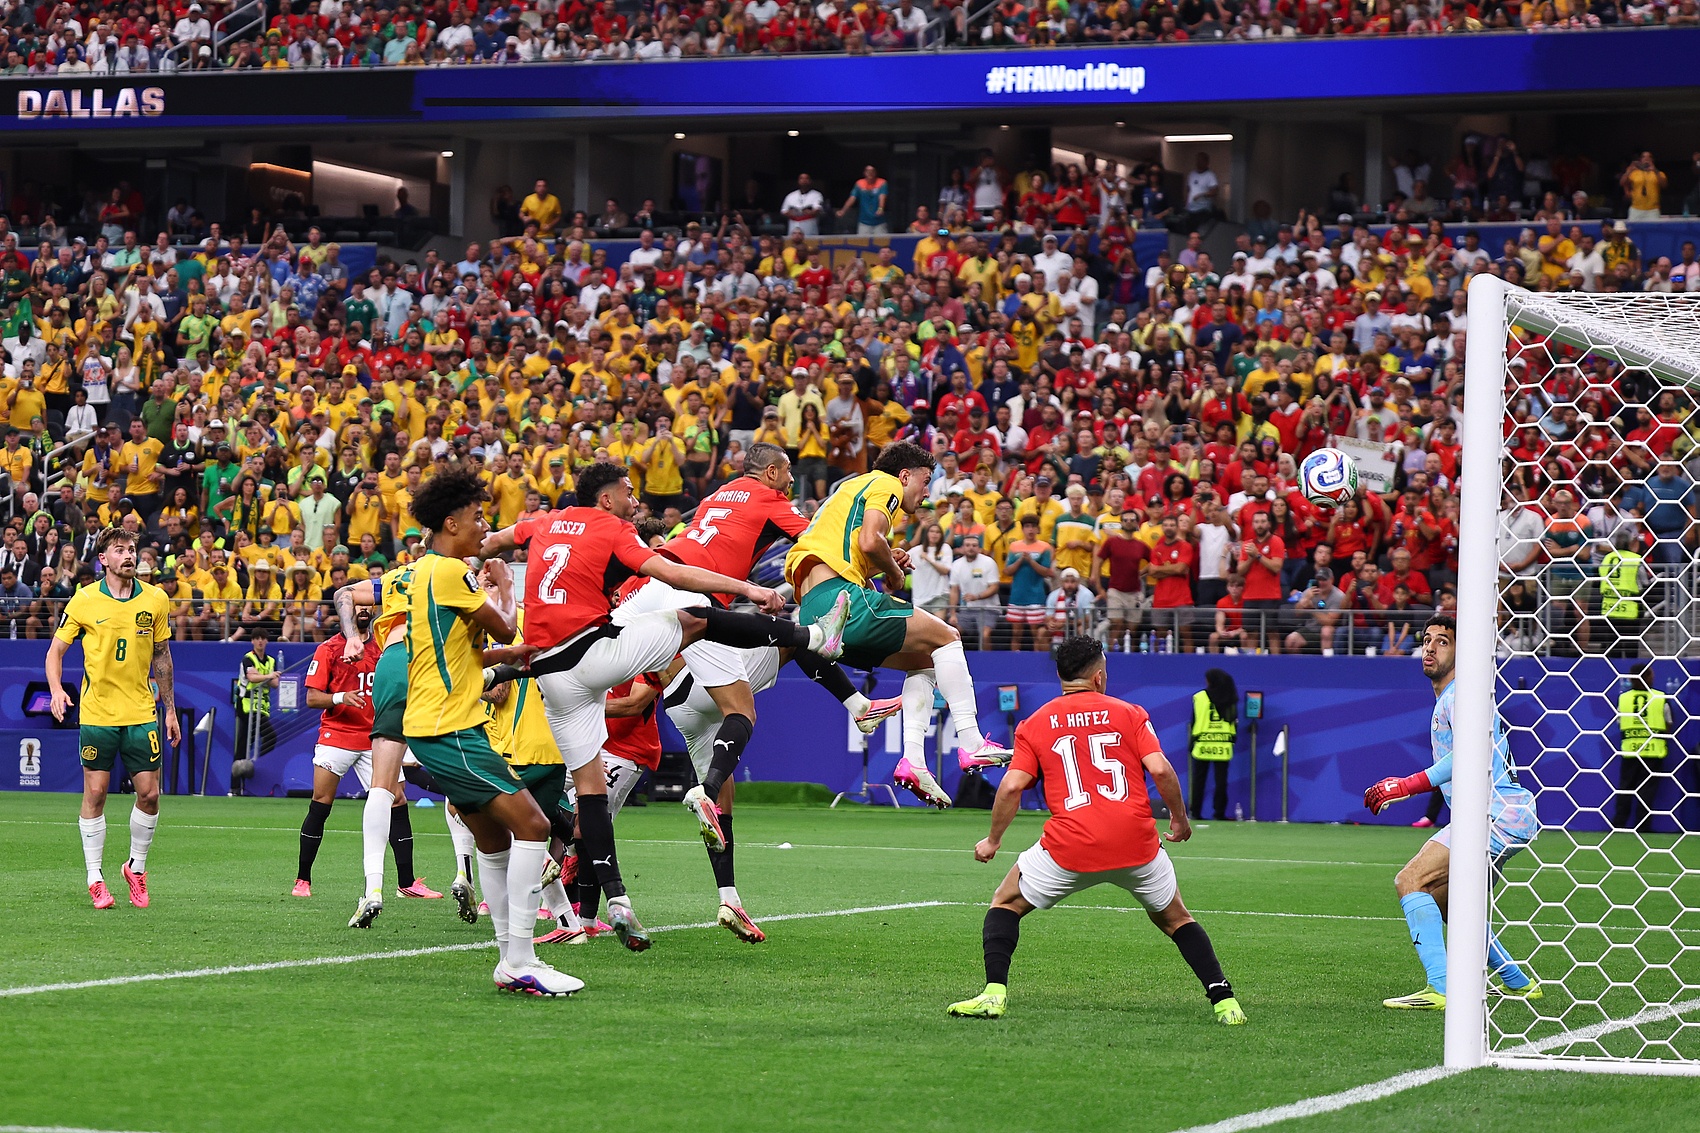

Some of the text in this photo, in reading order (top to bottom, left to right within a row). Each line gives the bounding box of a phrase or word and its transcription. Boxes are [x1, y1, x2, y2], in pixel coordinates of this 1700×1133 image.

[986, 63, 1146, 94] #FIFAWorldCup
[18, 87, 165, 119] DALLAS
[549, 520, 586, 535] YASSER
[686, 507, 733, 547] 5
[538, 543, 572, 604] 2
[115, 638, 127, 661] 8
[357, 671, 375, 696] 19
[1050, 710, 1110, 729] K. HAFEZ
[147, 730, 160, 754] 8
[1051, 732, 1129, 811] 15
